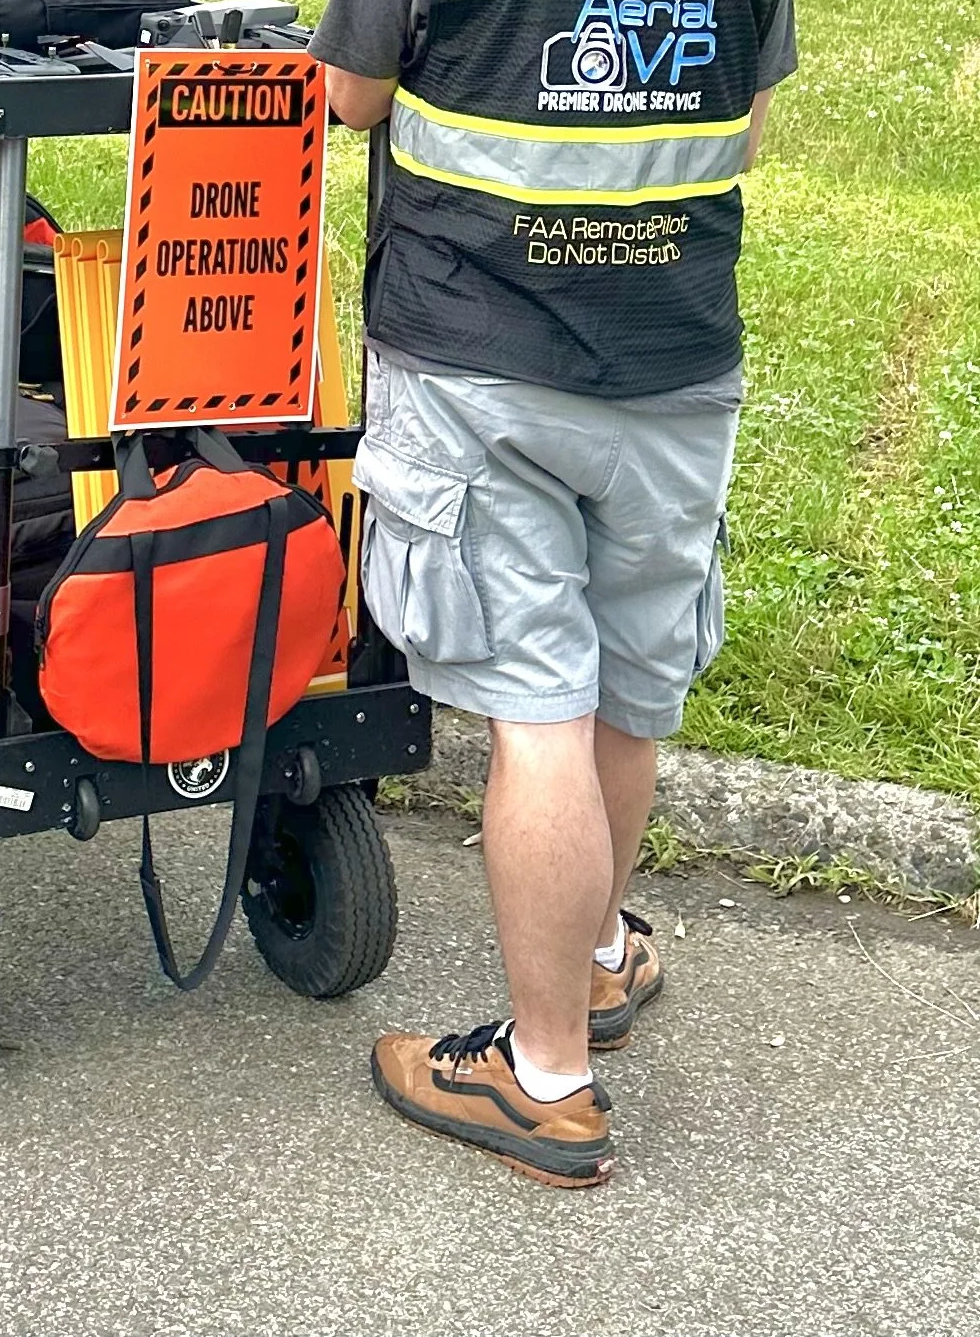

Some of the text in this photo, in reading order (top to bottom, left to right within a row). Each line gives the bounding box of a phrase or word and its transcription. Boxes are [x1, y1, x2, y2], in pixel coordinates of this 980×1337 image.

[627, 30, 717, 86] VP
[171, 84, 292, 122] CAUTION
[538, 90, 702, 112] PREMIER DRONE SERVICE
[190, 181, 262, 219] DRONE
[513, 214, 568, 240] FAA
[156, 237, 289, 277] OPERATIONS
[527, 239, 681, 265] Do Not Disturb
[183, 295, 256, 333] ABOVE
